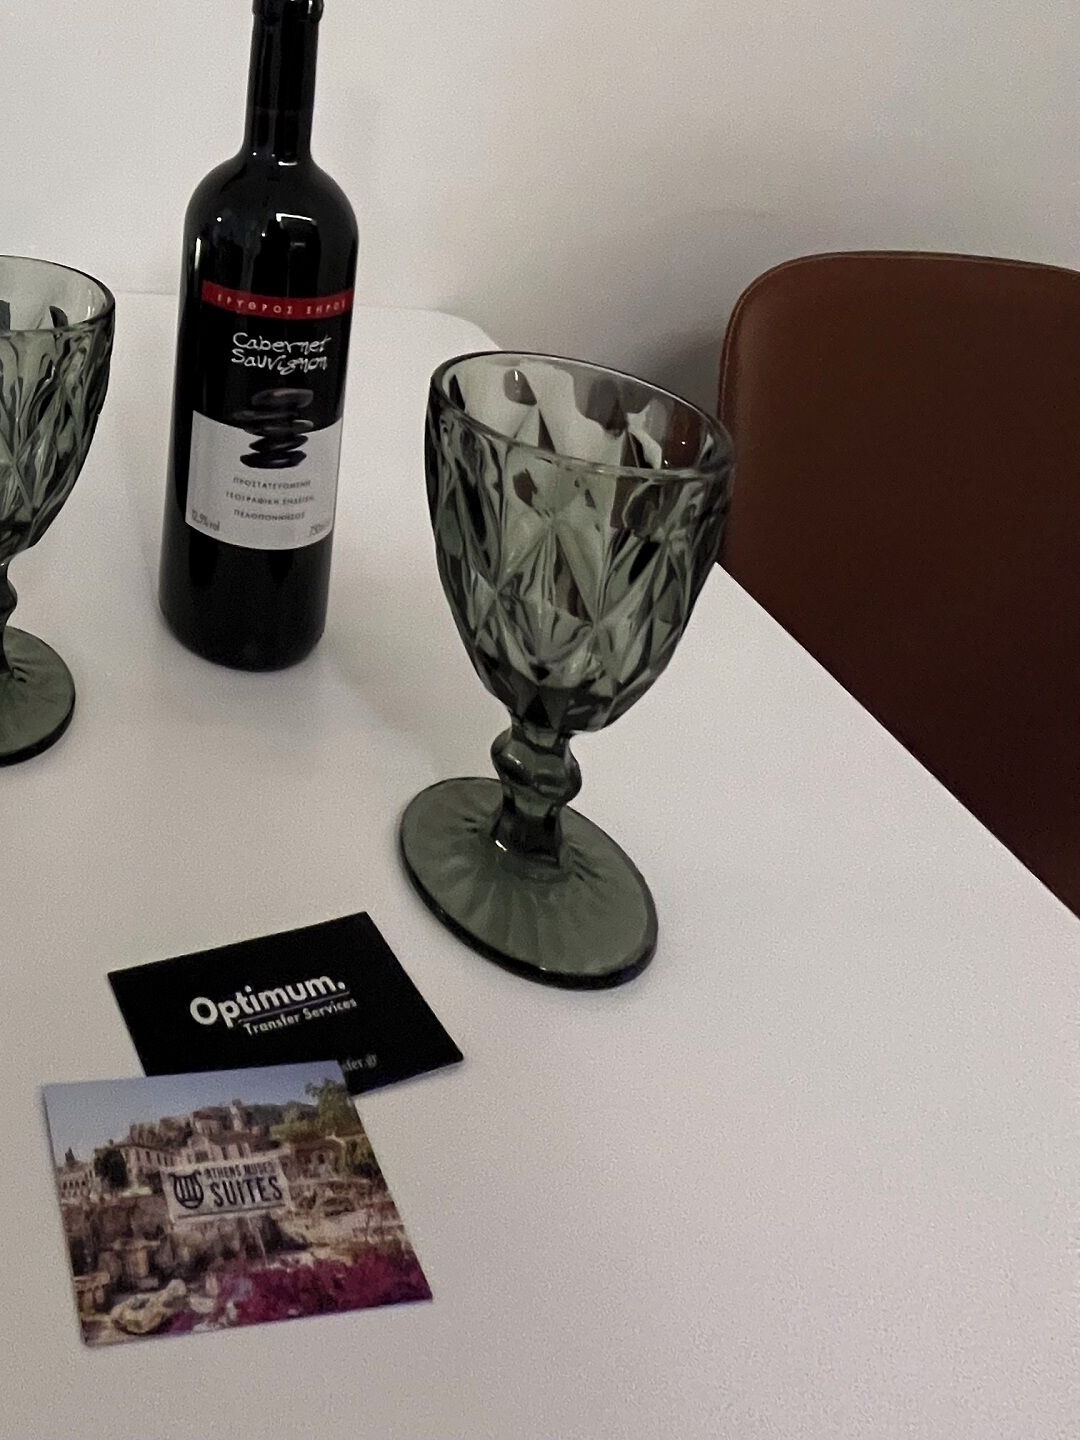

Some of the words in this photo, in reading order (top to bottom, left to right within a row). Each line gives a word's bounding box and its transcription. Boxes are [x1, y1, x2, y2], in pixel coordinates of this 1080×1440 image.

[232, 331, 332, 355] Cabernet
[231, 348, 328, 376] Sauvignon
[189, 975, 346, 1028] Optimum.
[243, 1014, 300, 1036] Transfer
[302, 997, 358, 1020] Services
[210, 1176, 282, 1207] SUITES
